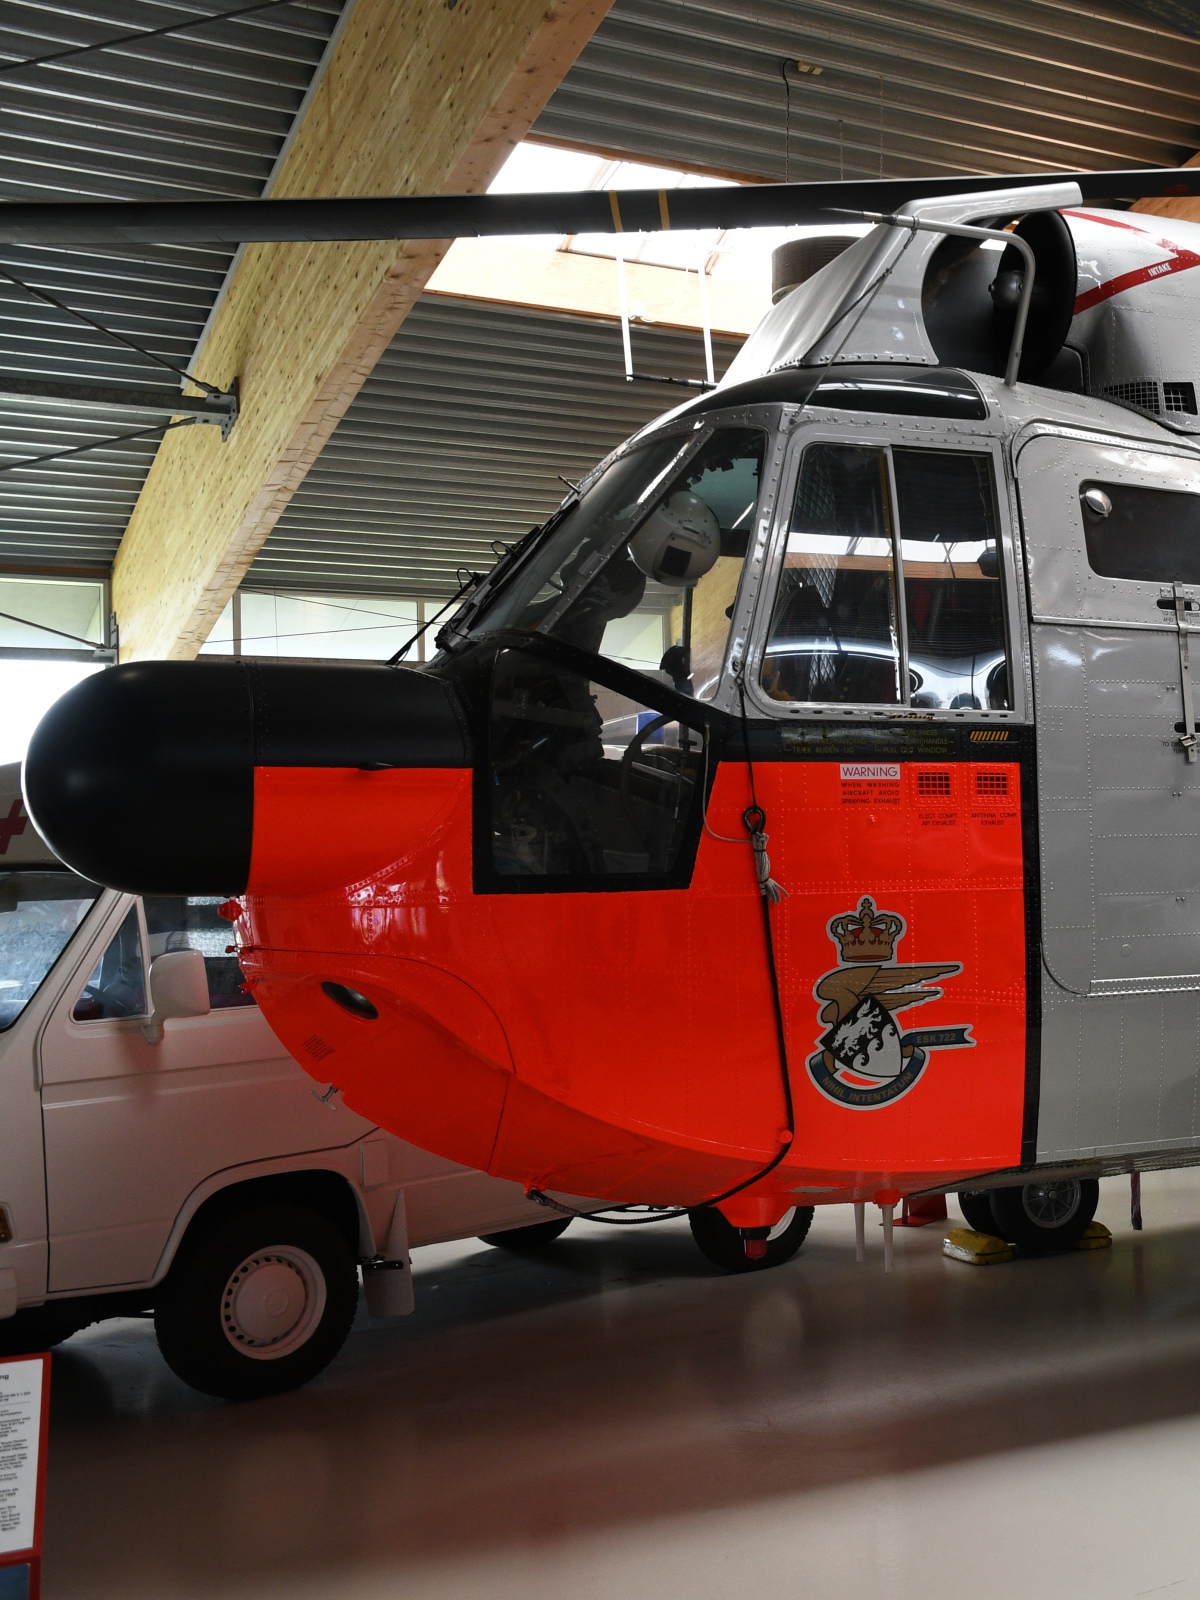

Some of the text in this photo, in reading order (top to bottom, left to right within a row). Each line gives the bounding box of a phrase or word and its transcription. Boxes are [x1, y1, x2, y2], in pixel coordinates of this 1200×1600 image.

[1148, 262, 1172, 276] INTAKE
[842, 766, 898, 777] WARNING
[916, 1032, 957, 1043] ESK 722
[822, 1072, 914, 1102] NIHIL INTENTATUM
